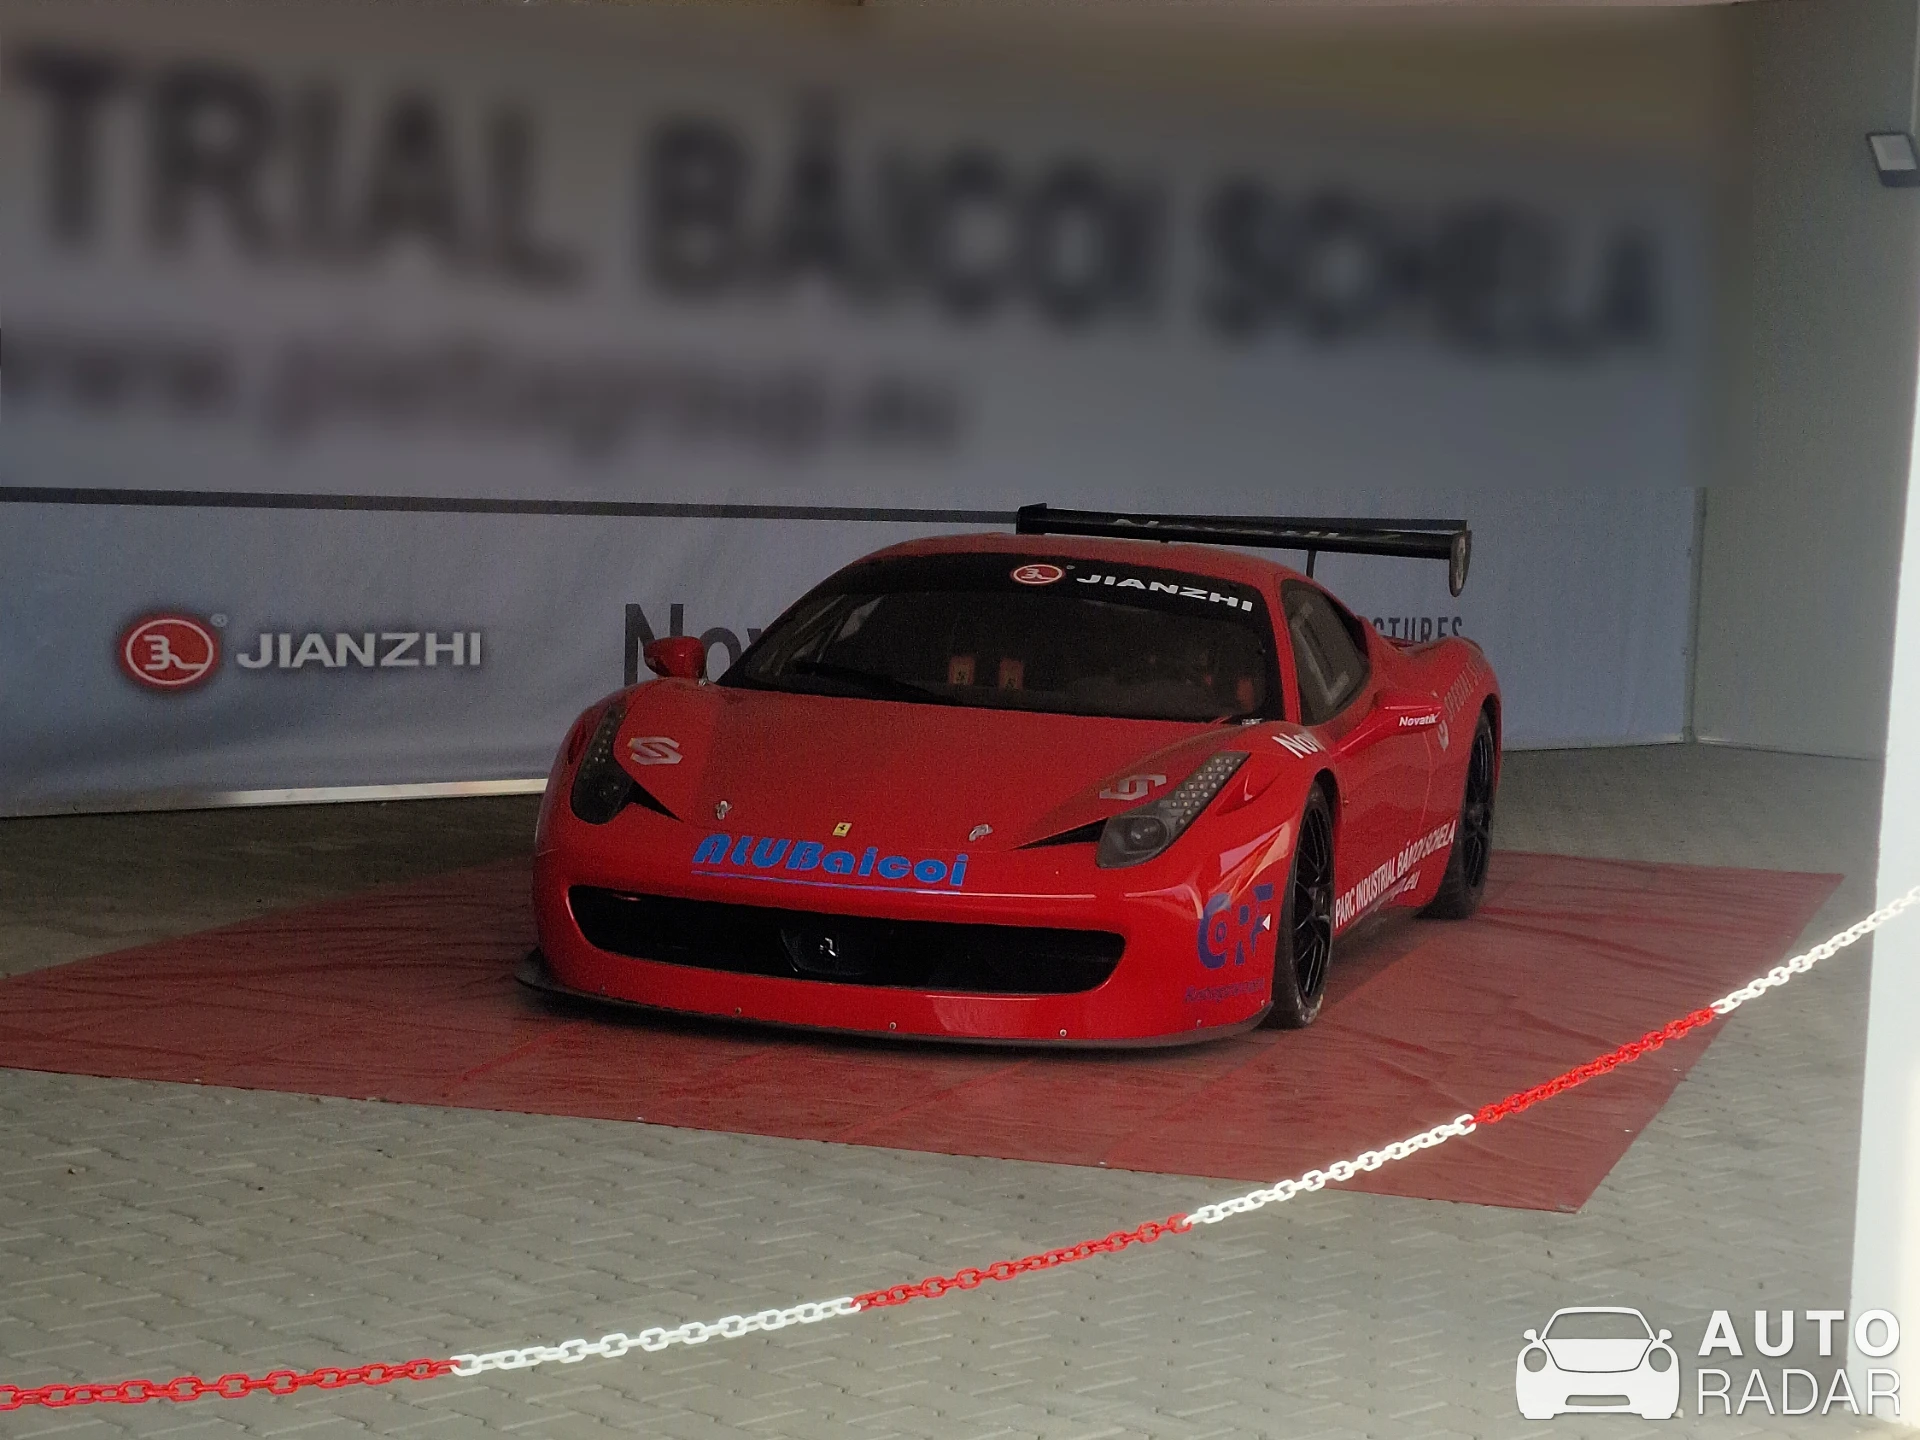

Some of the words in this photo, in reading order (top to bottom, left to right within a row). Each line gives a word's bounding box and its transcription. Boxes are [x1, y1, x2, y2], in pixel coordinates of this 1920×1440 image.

[15, 50, 582, 292] TRIAL
[1075, 573, 1254, 612] JIANZHI
[236, 631, 482, 668] JIANZHI
[1335, 886, 1356, 928] PARC
[1356, 857, 1397, 912] INDUSTRIAL
